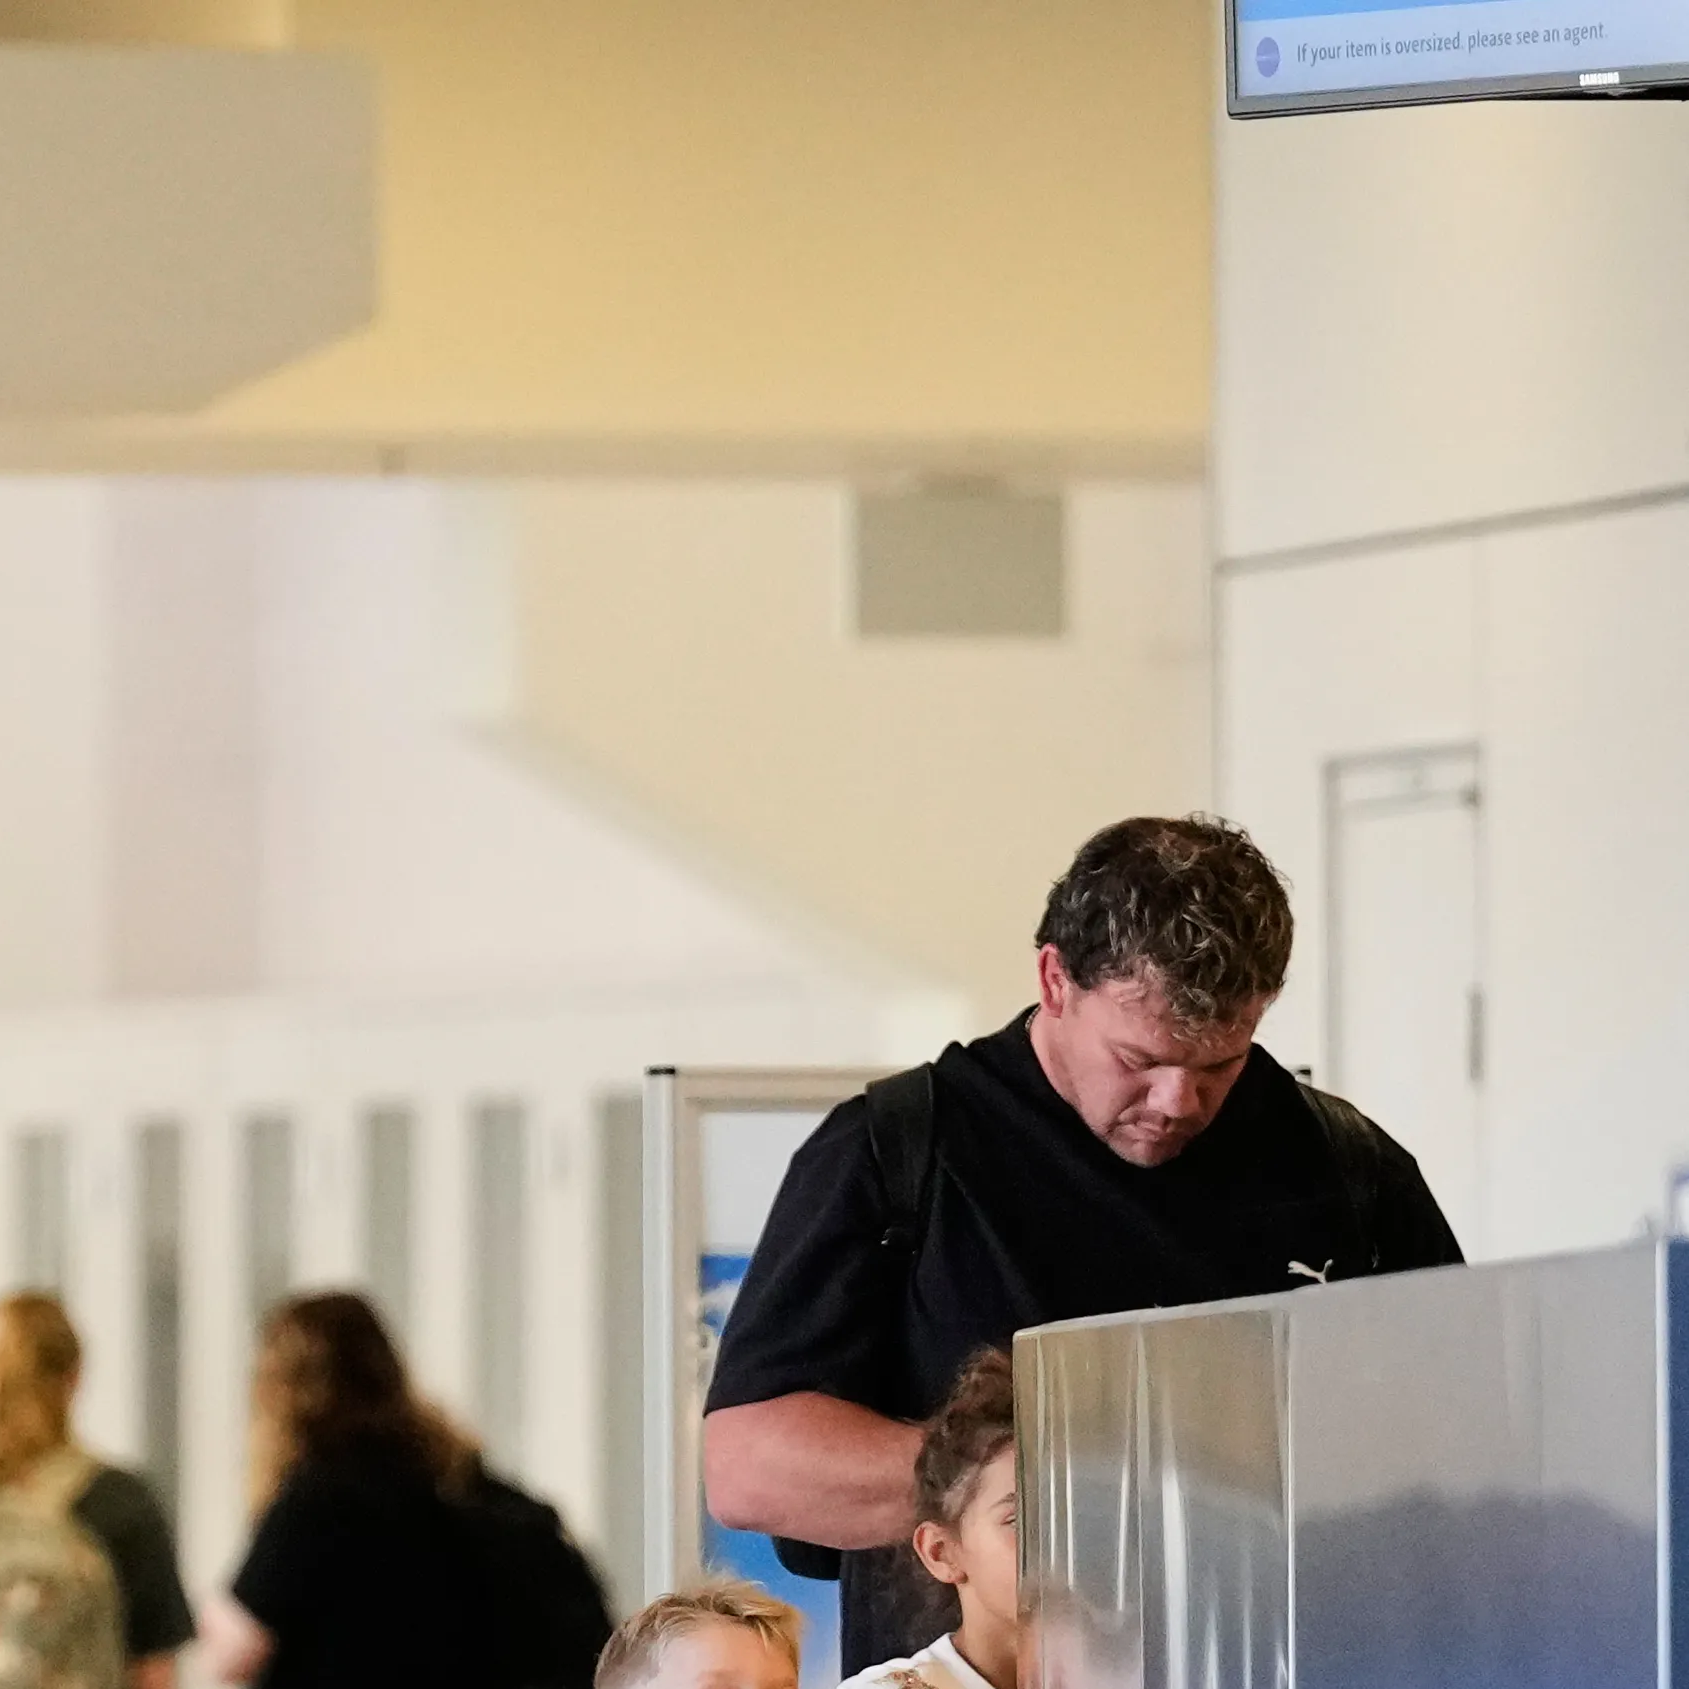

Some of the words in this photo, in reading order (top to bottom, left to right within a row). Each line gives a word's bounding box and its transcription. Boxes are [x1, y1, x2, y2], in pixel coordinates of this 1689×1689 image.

[1296, 43, 1308, 62] If
[1310, 44, 1342, 67] your
[1346, 39, 1377, 58] item
[1380, 36, 1391, 56] is
[1467, 29, 1512, 53] please
[1516, 30, 1539, 45] see
[1543, 28, 1560, 42] an
[1563, 22, 1608, 46] agent.
[1578, 71, 1620, 87] SAMSUNG
